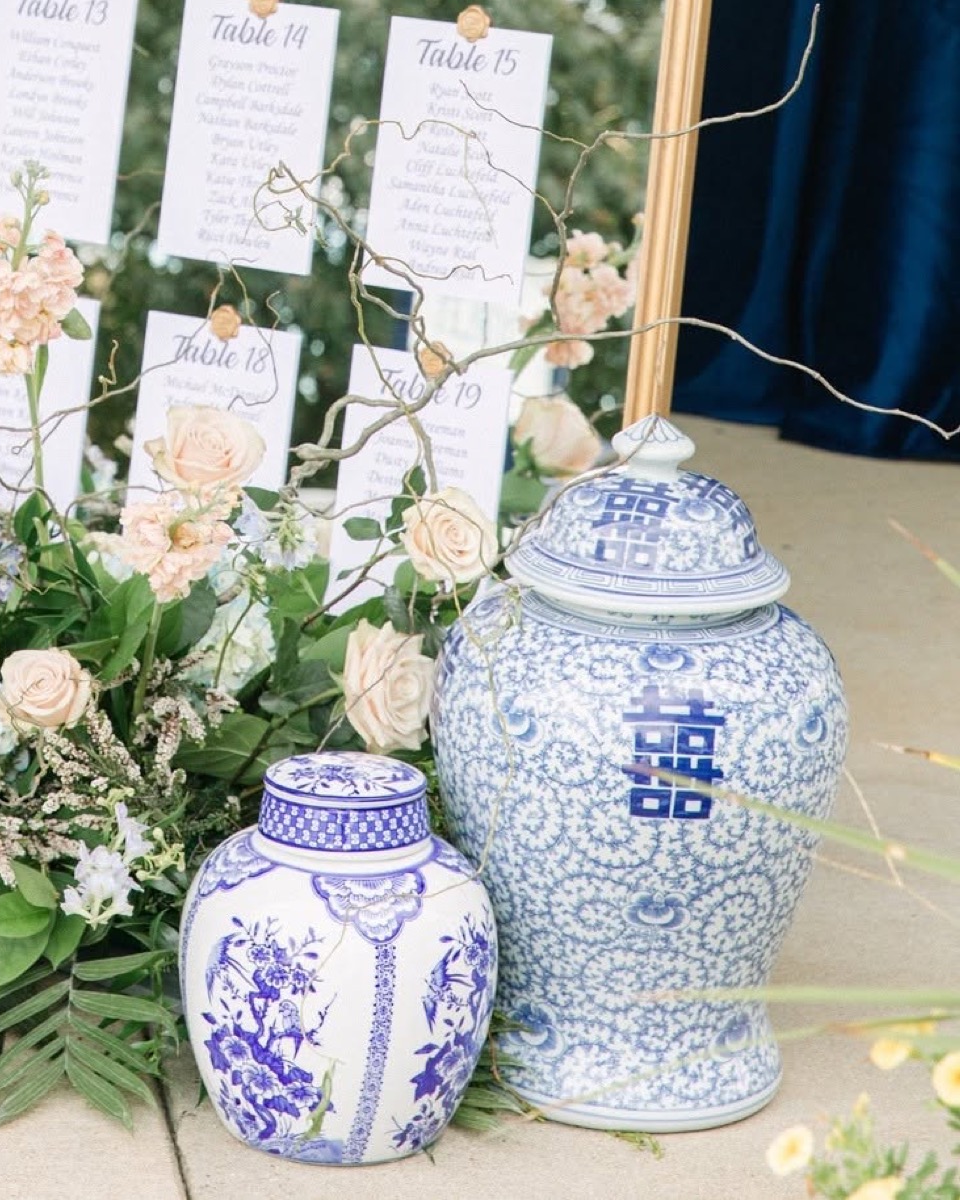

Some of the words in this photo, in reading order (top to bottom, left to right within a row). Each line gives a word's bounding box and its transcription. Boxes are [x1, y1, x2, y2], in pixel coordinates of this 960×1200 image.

[210, 14, 277, 47] Table
[284, 22, 309, 49] 14
[417, 39, 488, 72] Table
[494, 48, 520, 76] 15
[173, 334, 238, 370] Table
[246, 346, 270, 374] 18
[379, 368, 450, 405] Tabe
[455, 381, 482, 410] 19
